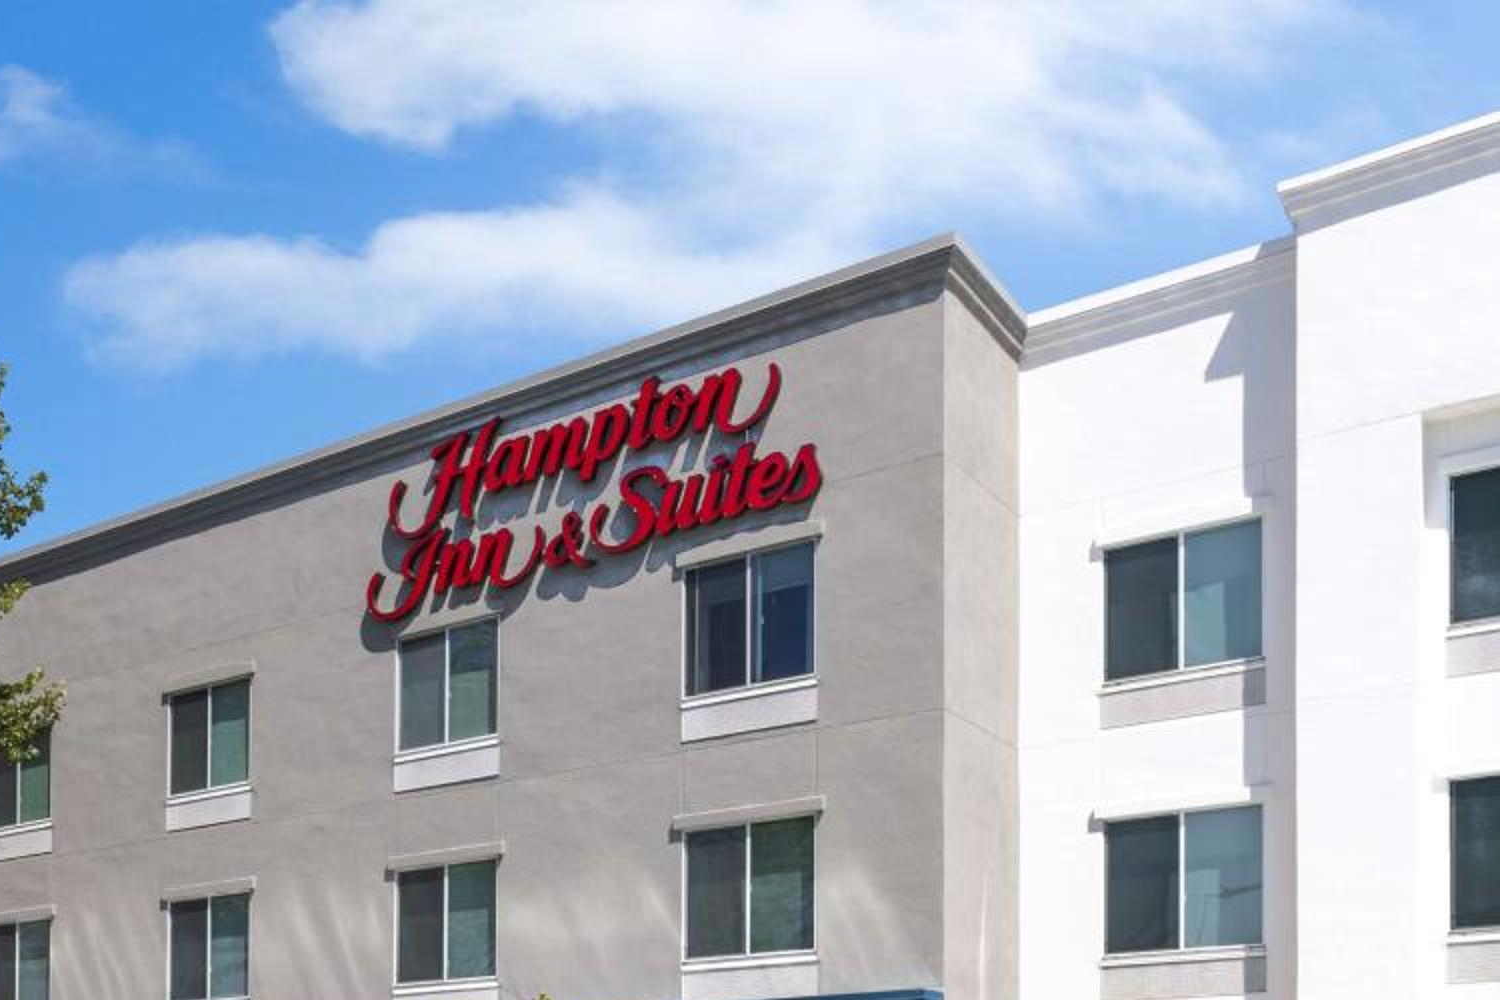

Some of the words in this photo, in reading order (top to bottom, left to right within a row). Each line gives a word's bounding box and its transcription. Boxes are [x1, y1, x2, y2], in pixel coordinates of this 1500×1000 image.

[366, 524, 545, 622] Inn
[543, 510, 596, 569] &
[589, 441, 822, 555] Suites
[389, 361, 782, 538] Hampton
